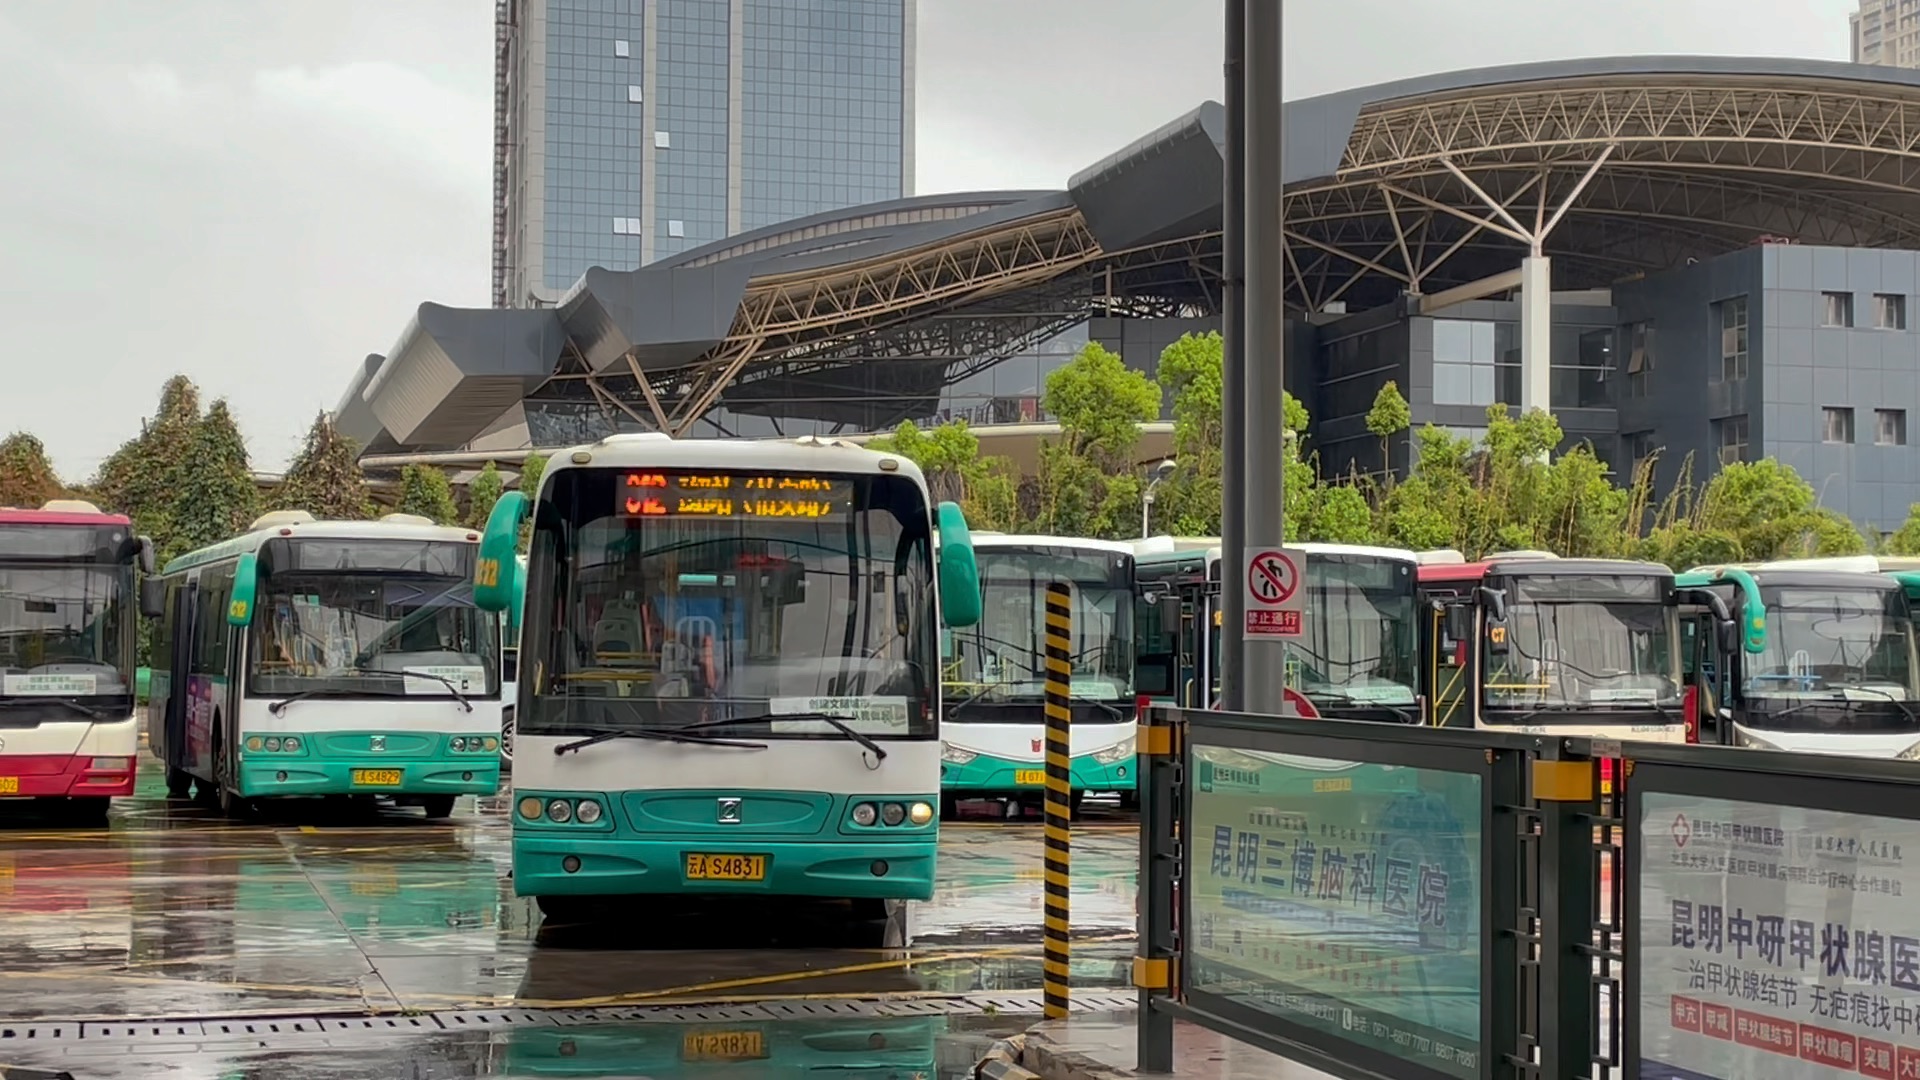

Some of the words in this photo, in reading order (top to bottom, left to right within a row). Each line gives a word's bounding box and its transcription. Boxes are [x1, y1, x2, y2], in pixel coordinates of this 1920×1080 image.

[1248, 611, 1297, 625] 禁止通行
[1491, 627, 1505, 643] C7
[1210, 825, 1450, 928] 昆明三博脑科医院
[1671, 899, 1920, 991] 昆明中研甲状腺医
[1675, 1003, 1697, 1025] 甲亢
[1706, 1009, 1729, 1033] 甲减
[1738, 1017, 1793, 1047] 甲状腺结节
